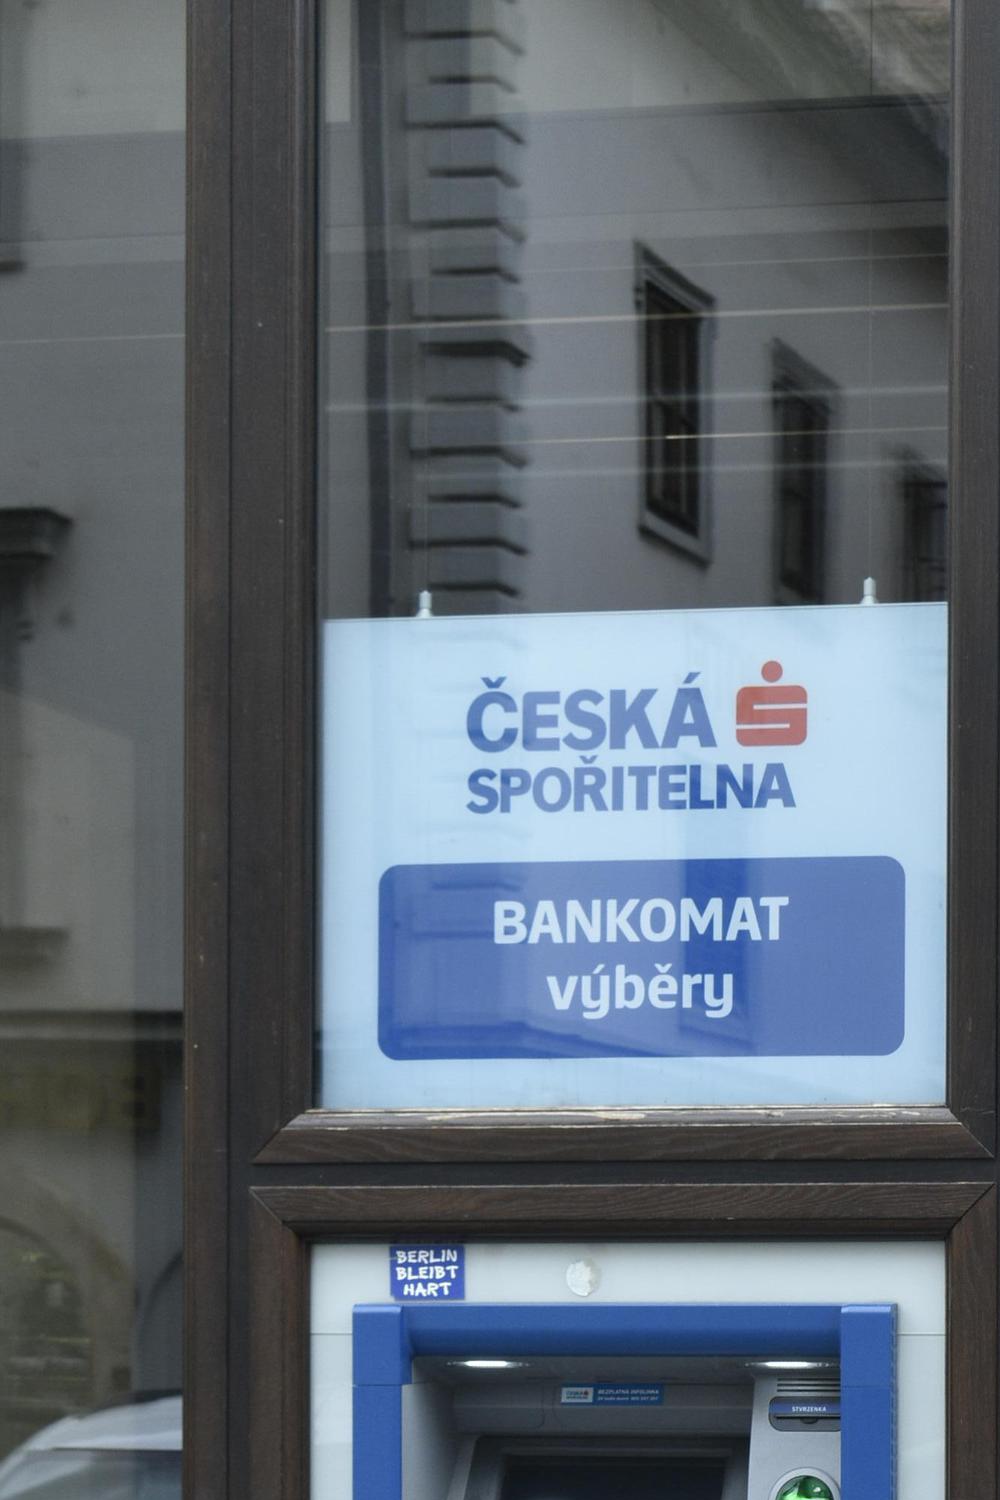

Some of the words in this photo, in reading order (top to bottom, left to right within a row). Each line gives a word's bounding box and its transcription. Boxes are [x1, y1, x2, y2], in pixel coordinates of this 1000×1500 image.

[466, 672, 717, 753] ČESKÁ
[466, 755, 797, 814] SPOŘITELNA
[493, 896, 790, 945] BANKOMAT
[546, 962, 734, 1019] výběry
[395, 1265, 459, 1281] BLEIBT
[396, 1249, 458, 1264] BERLIN
[403, 1282, 452, 1297] HART
